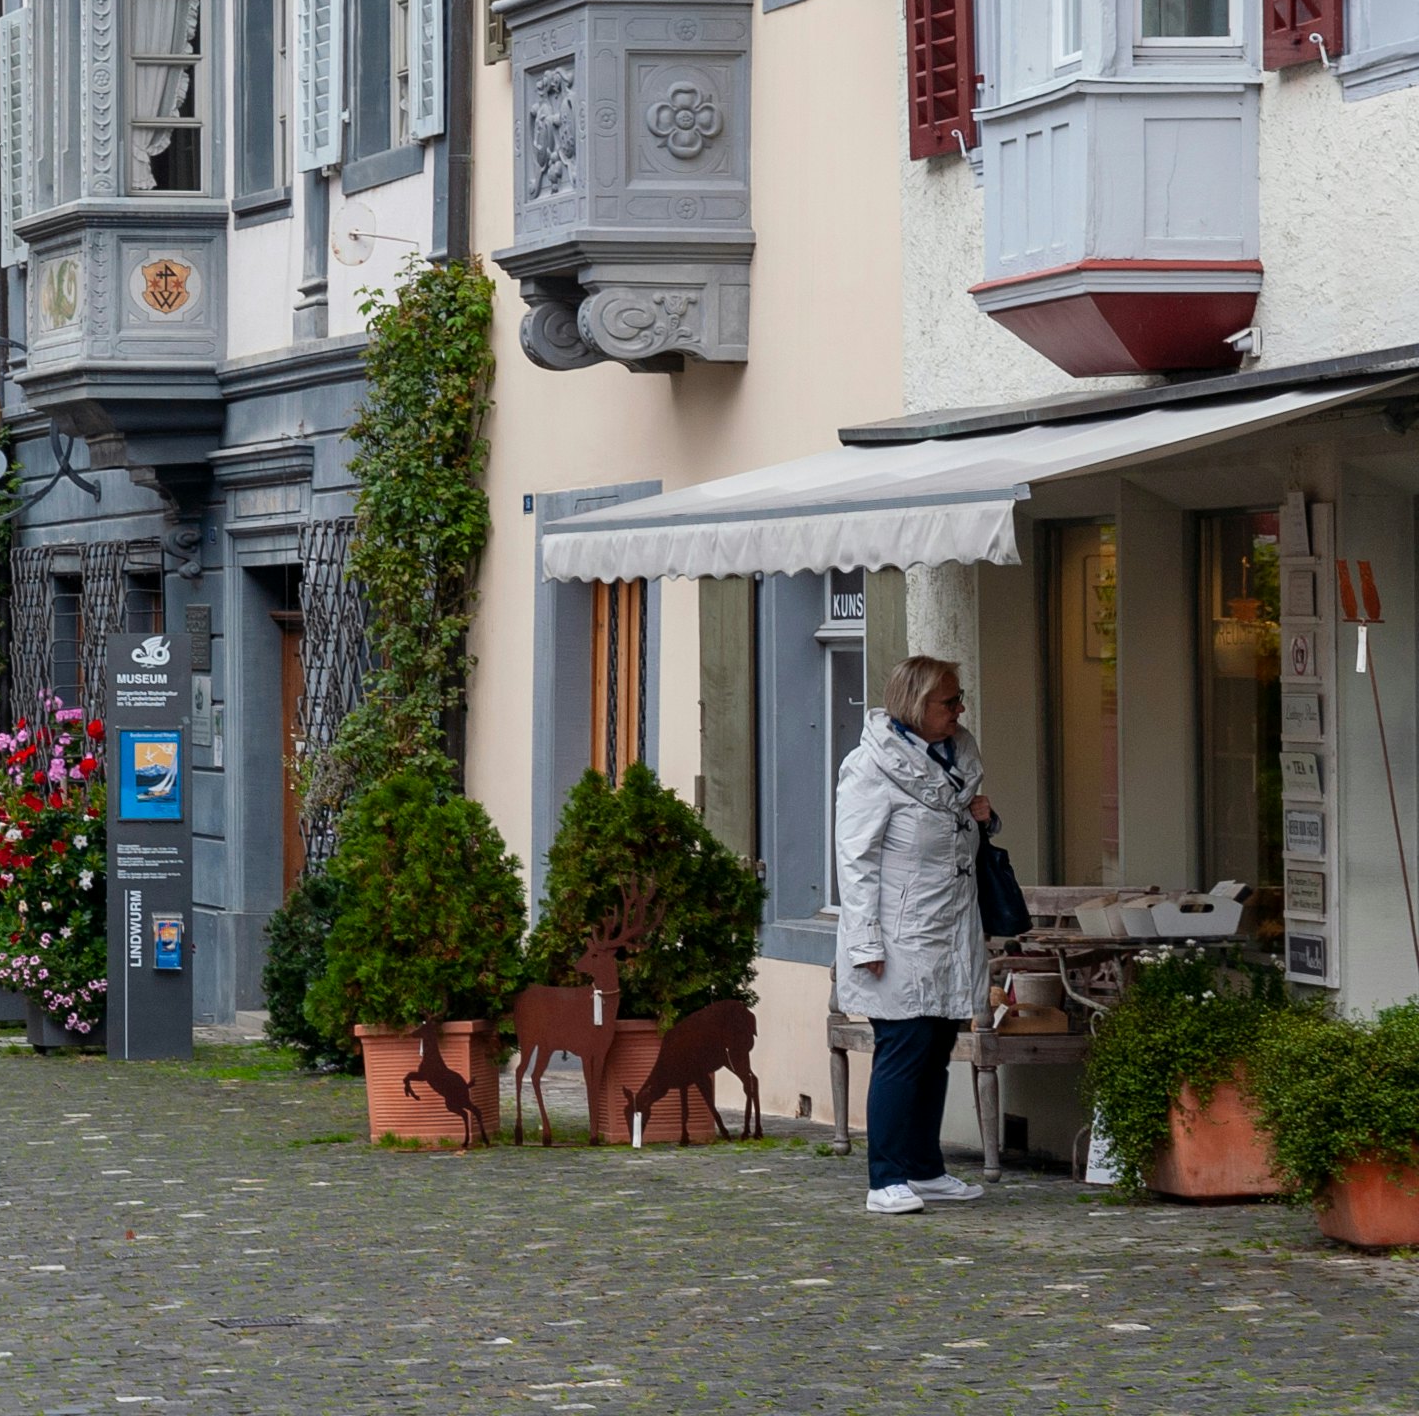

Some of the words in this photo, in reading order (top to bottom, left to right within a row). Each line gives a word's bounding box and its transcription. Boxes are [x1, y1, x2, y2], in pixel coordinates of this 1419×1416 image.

[833, 592, 863, 617] KUNS
[116, 673, 167, 684] MUSEUM
[129, 890, 142, 968] LINDWURM
